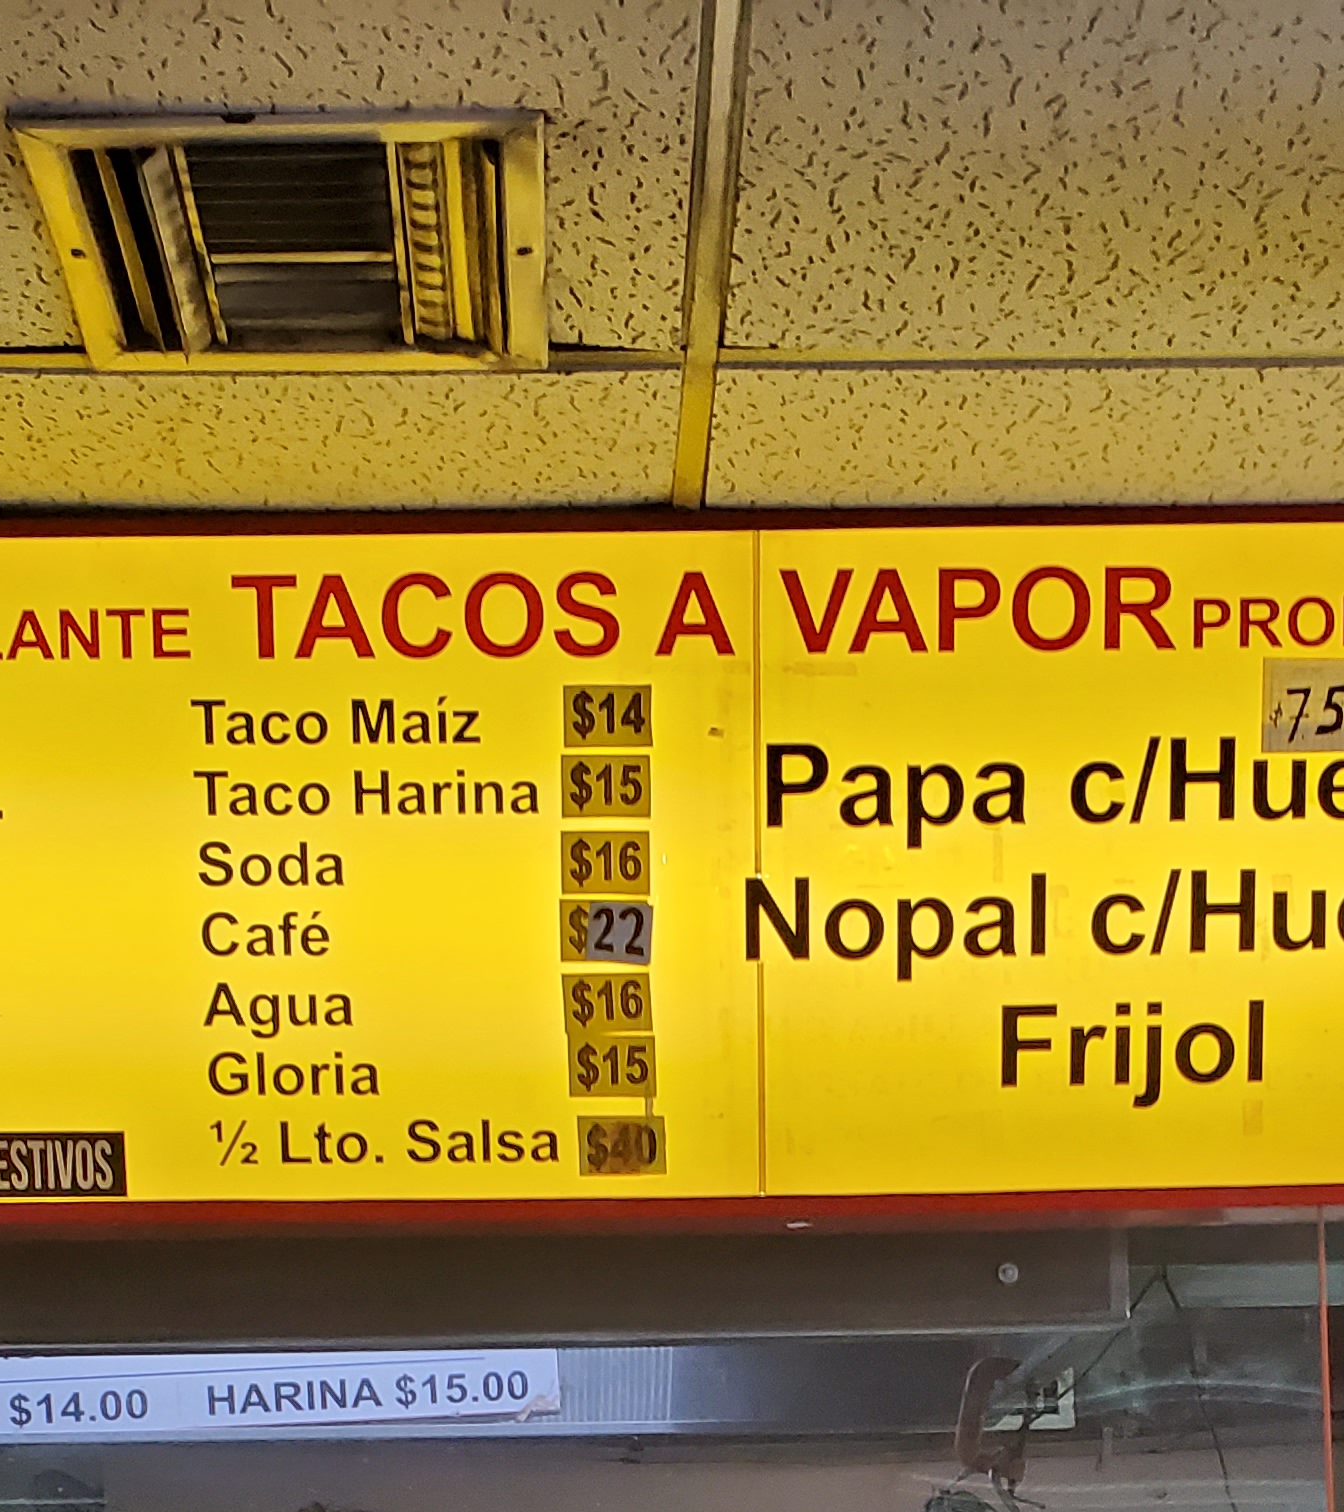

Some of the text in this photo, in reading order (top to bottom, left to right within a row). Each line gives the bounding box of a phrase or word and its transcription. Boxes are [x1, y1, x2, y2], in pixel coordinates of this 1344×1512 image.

[232, 566, 1176, 659] TACOS A VAPOR
[191, 696, 480, 744] Taco Maíz
[572, 690, 645, 738] $14
[194, 770, 538, 816] Taco Harina
[570, 761, 642, 809] $15
[767, 744, 1025, 848] Papa
[199, 842, 343, 886] Soda
[569, 840, 642, 888] $16
[202, 911, 329, 956] Café
[568, 906, 646, 957] $22
[744, 873, 1048, 981] Nopal
[204, 983, 352, 1038] Agua
[571, 979, 643, 1026] $16
[209, 1052, 379, 1096] Gloria
[577, 1043, 649, 1091] $15
[1002, 1000, 1264, 1108] Frijol
[280, 1122, 383, 1163] Lto.
[407, 1120, 559, 1162] Salsa
[10, 1390, 147, 1428] $14.00
[208, 1378, 382, 1415] HARINA
[396, 1371, 528, 1409] $15.00
